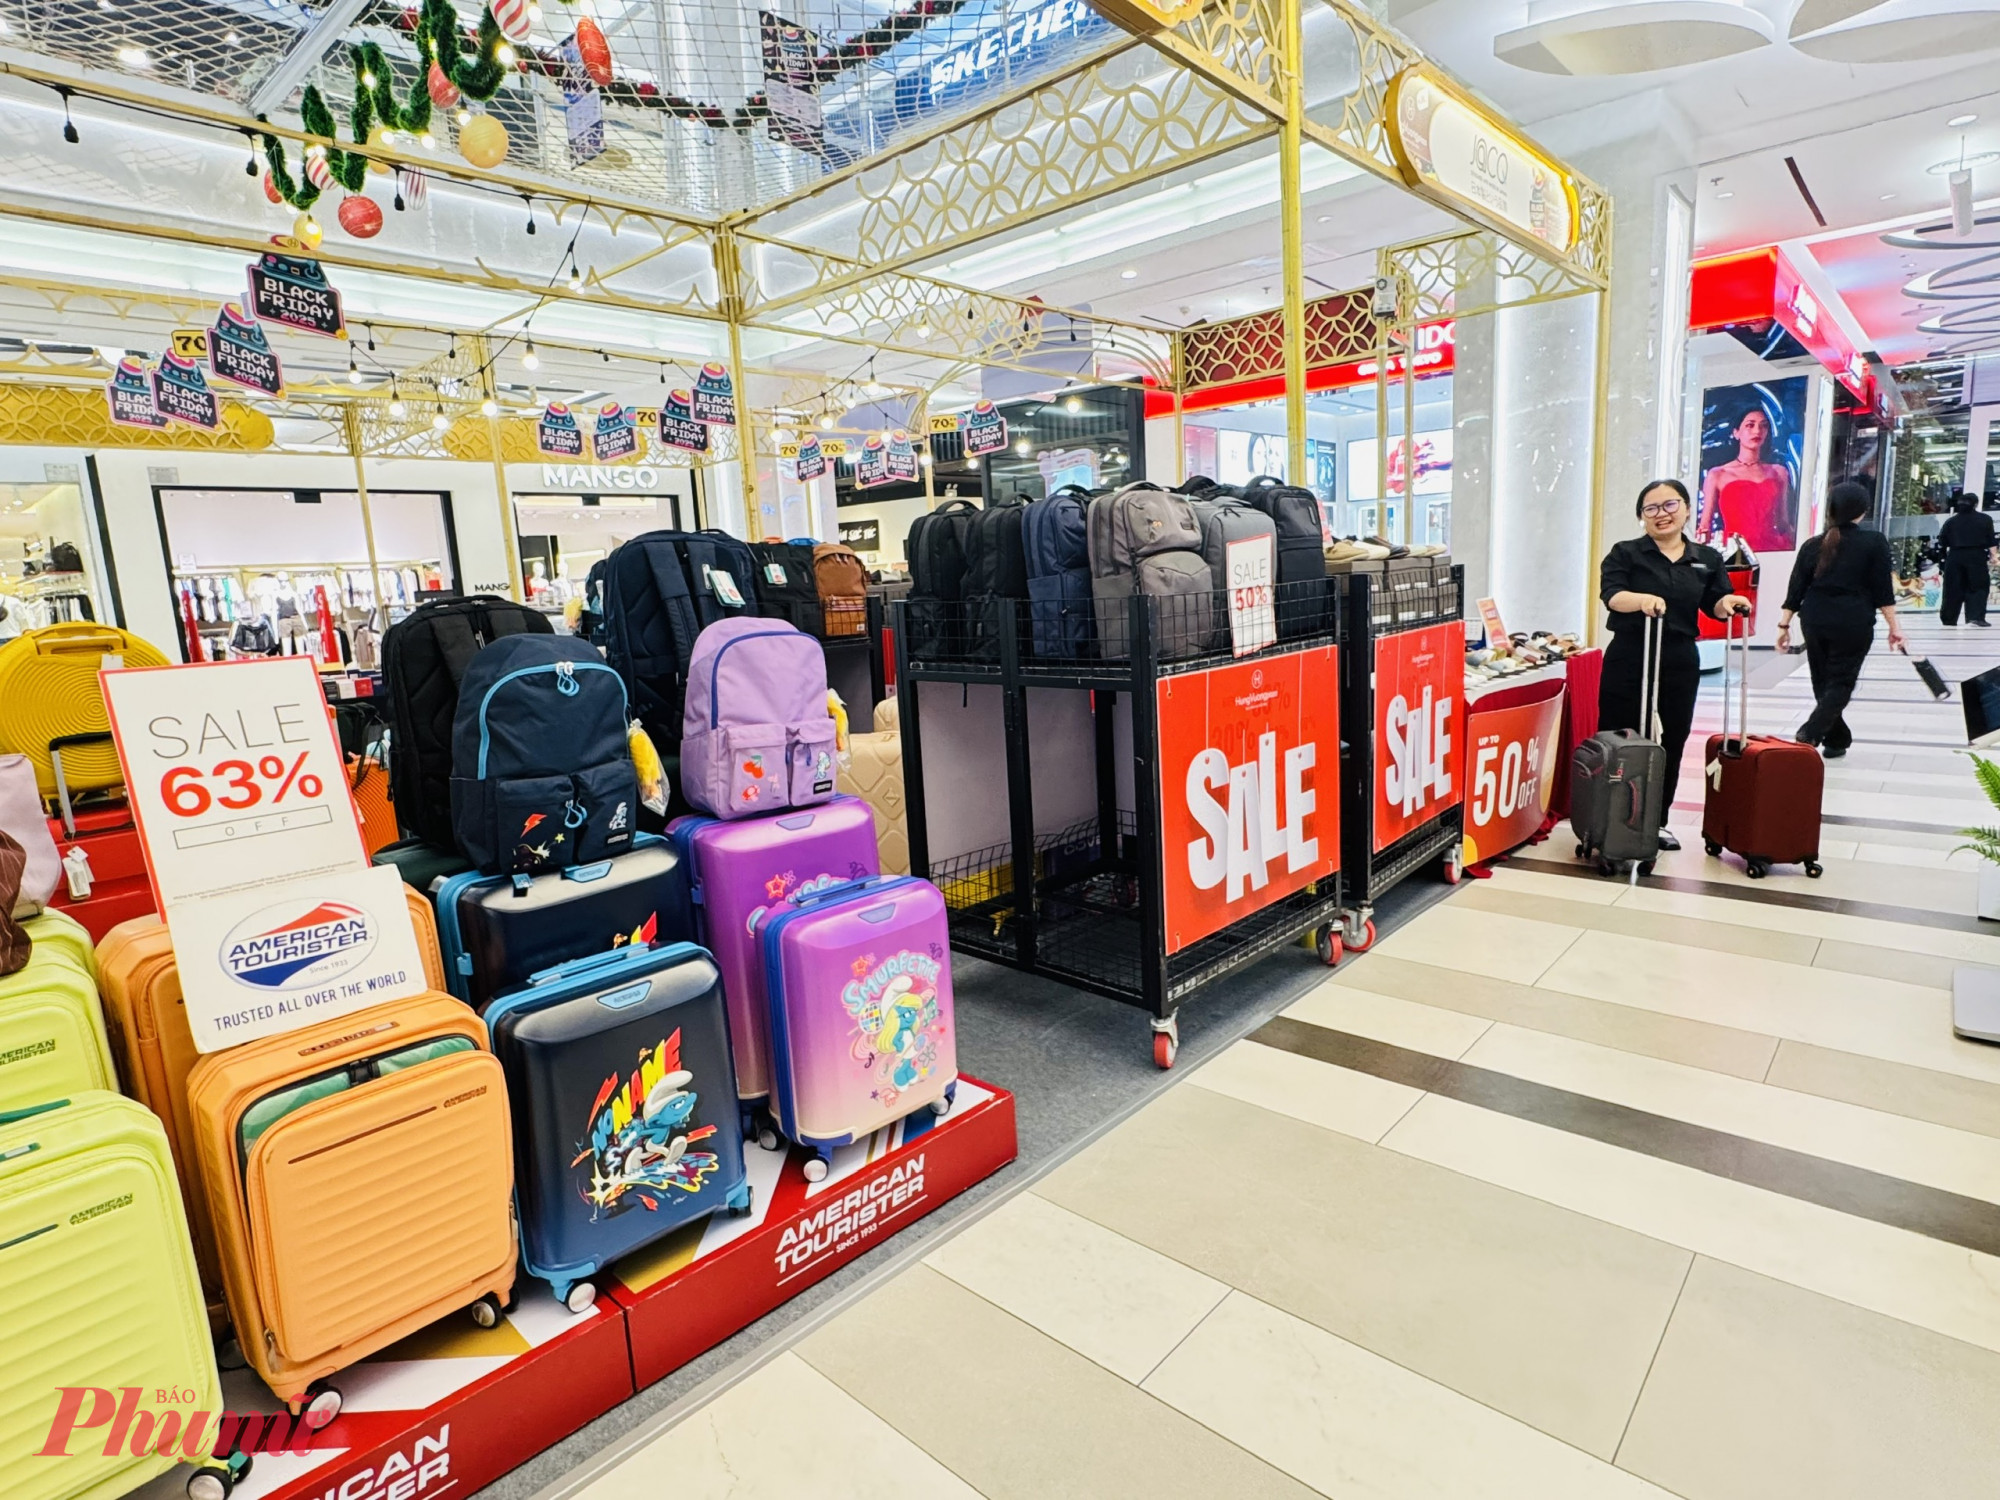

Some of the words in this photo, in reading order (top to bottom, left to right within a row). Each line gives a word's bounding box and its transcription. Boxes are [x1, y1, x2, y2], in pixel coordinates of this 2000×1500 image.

[929, 0, 1096, 94] SKECHER
[263, 277, 327, 305] BLACK
[259, 291, 334, 321] FRIDAY
[280, 309, 317, 327] 2025
[217, 351, 275, 381] FRIDAY
[219, 339, 270, 368] BLACK
[233, 370, 262, 386] 2025
[117, 391, 152, 405] BLAC
[160, 391, 213, 417] FRIDAY
[162, 381, 208, 406] BLACK
[115, 401, 156, 416] FRIDA
[174, 407, 200, 422] 2025
[544, 427, 577, 439] BLACK
[597, 428, 628, 444] BLACK
[663, 426, 705, 442] FRIDAY
[666, 418, 702, 433] BLACK
[971, 425, 999, 437] BLACK
[542, 435, 579, 448] FRIDAY
[596, 436, 632, 454] FRIDAY
[969, 432, 1002, 446] FRIDAY
[888, 462, 914, 471] FRIDAY
[889, 455, 912, 463] BLACK
[542, 463, 659, 489] MANGO
[1234, 558, 1267, 585] SALE
[474, 584, 510, 592] MANG
[1235, 582, 1267, 611] 50%
[148, 703, 311, 759] SALE
[1478, 736, 1489, 746] UP
[1489, 735, 1500, 744] TO
[1385, 685, 1452, 818] SALE
[160, 751, 323, 817] 63%
[1518, 776, 1538, 810] OFF
[1186, 731, 1318, 904] SALE
[229, 918, 366, 958] AMERICAN
[229, 930, 368, 970] TOURISTER
[843, 950, 941, 1014] SMURFETTE
[214, 1005, 273, 1031] TRUSTED
[278, 998, 301, 1015] ALL
[305, 989, 337, 1008] OVER
[340, 982, 363, 998] THE
[366, 971, 406, 990] WORLD
[0, 1039, 55, 1059] MERICAN
[70, 1193, 133, 1220] AMERICAN
[776, 1153, 925, 1253] AMERICAN
[775, 1174, 924, 1274] TOURISTER
[836, 1233, 860, 1253] SINCE
[860, 1223, 878, 1238] 1933
